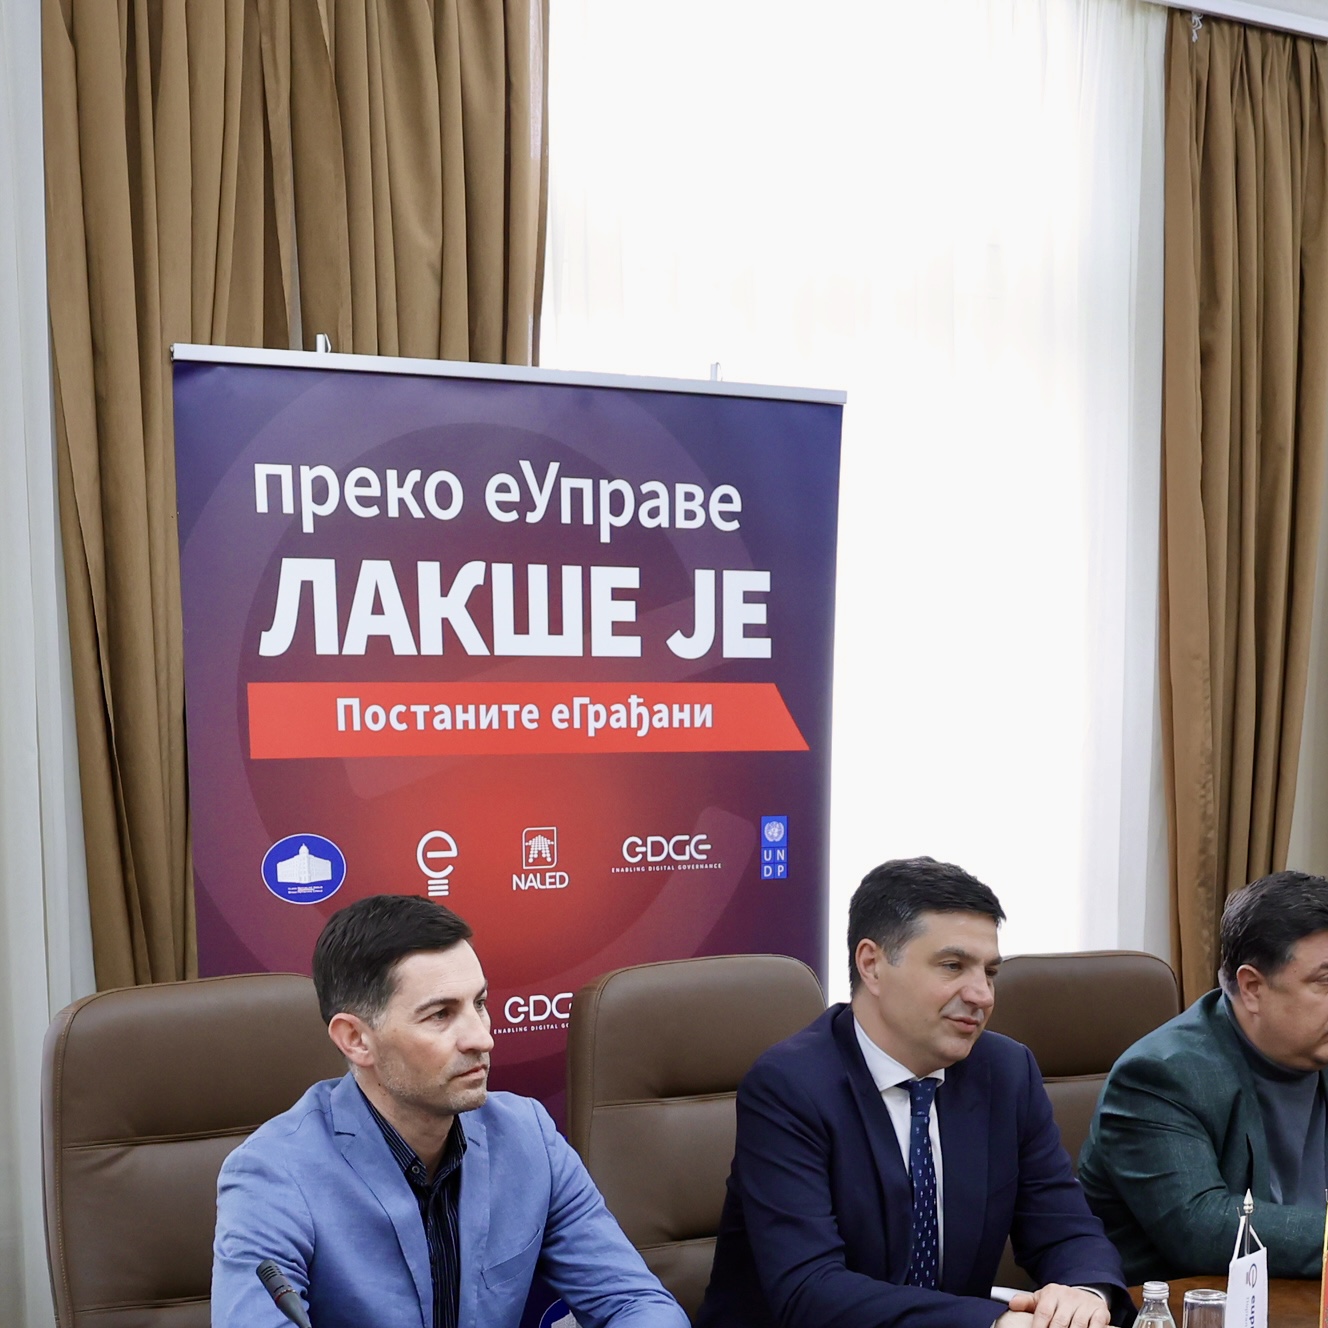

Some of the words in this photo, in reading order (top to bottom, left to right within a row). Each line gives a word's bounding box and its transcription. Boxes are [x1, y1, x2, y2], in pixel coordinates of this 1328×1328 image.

[254, 462, 464, 534] преко
[484, 459, 743, 543] еУправе
[258, 556, 642, 658] ЛАКШЕ
[665, 568, 773, 660] ЈЕ
[336, 697, 540, 733] Постаните
[551, 693, 714, 738] еГрађани
[512, 871, 569, 891] NALED
[611, 866, 646, 874] ENABLING
[677, 862, 722, 871] GOVERNANCE
[493, 1026, 528, 1035] ENABLING
[530, 1024, 558, 1032] DIGITAL
